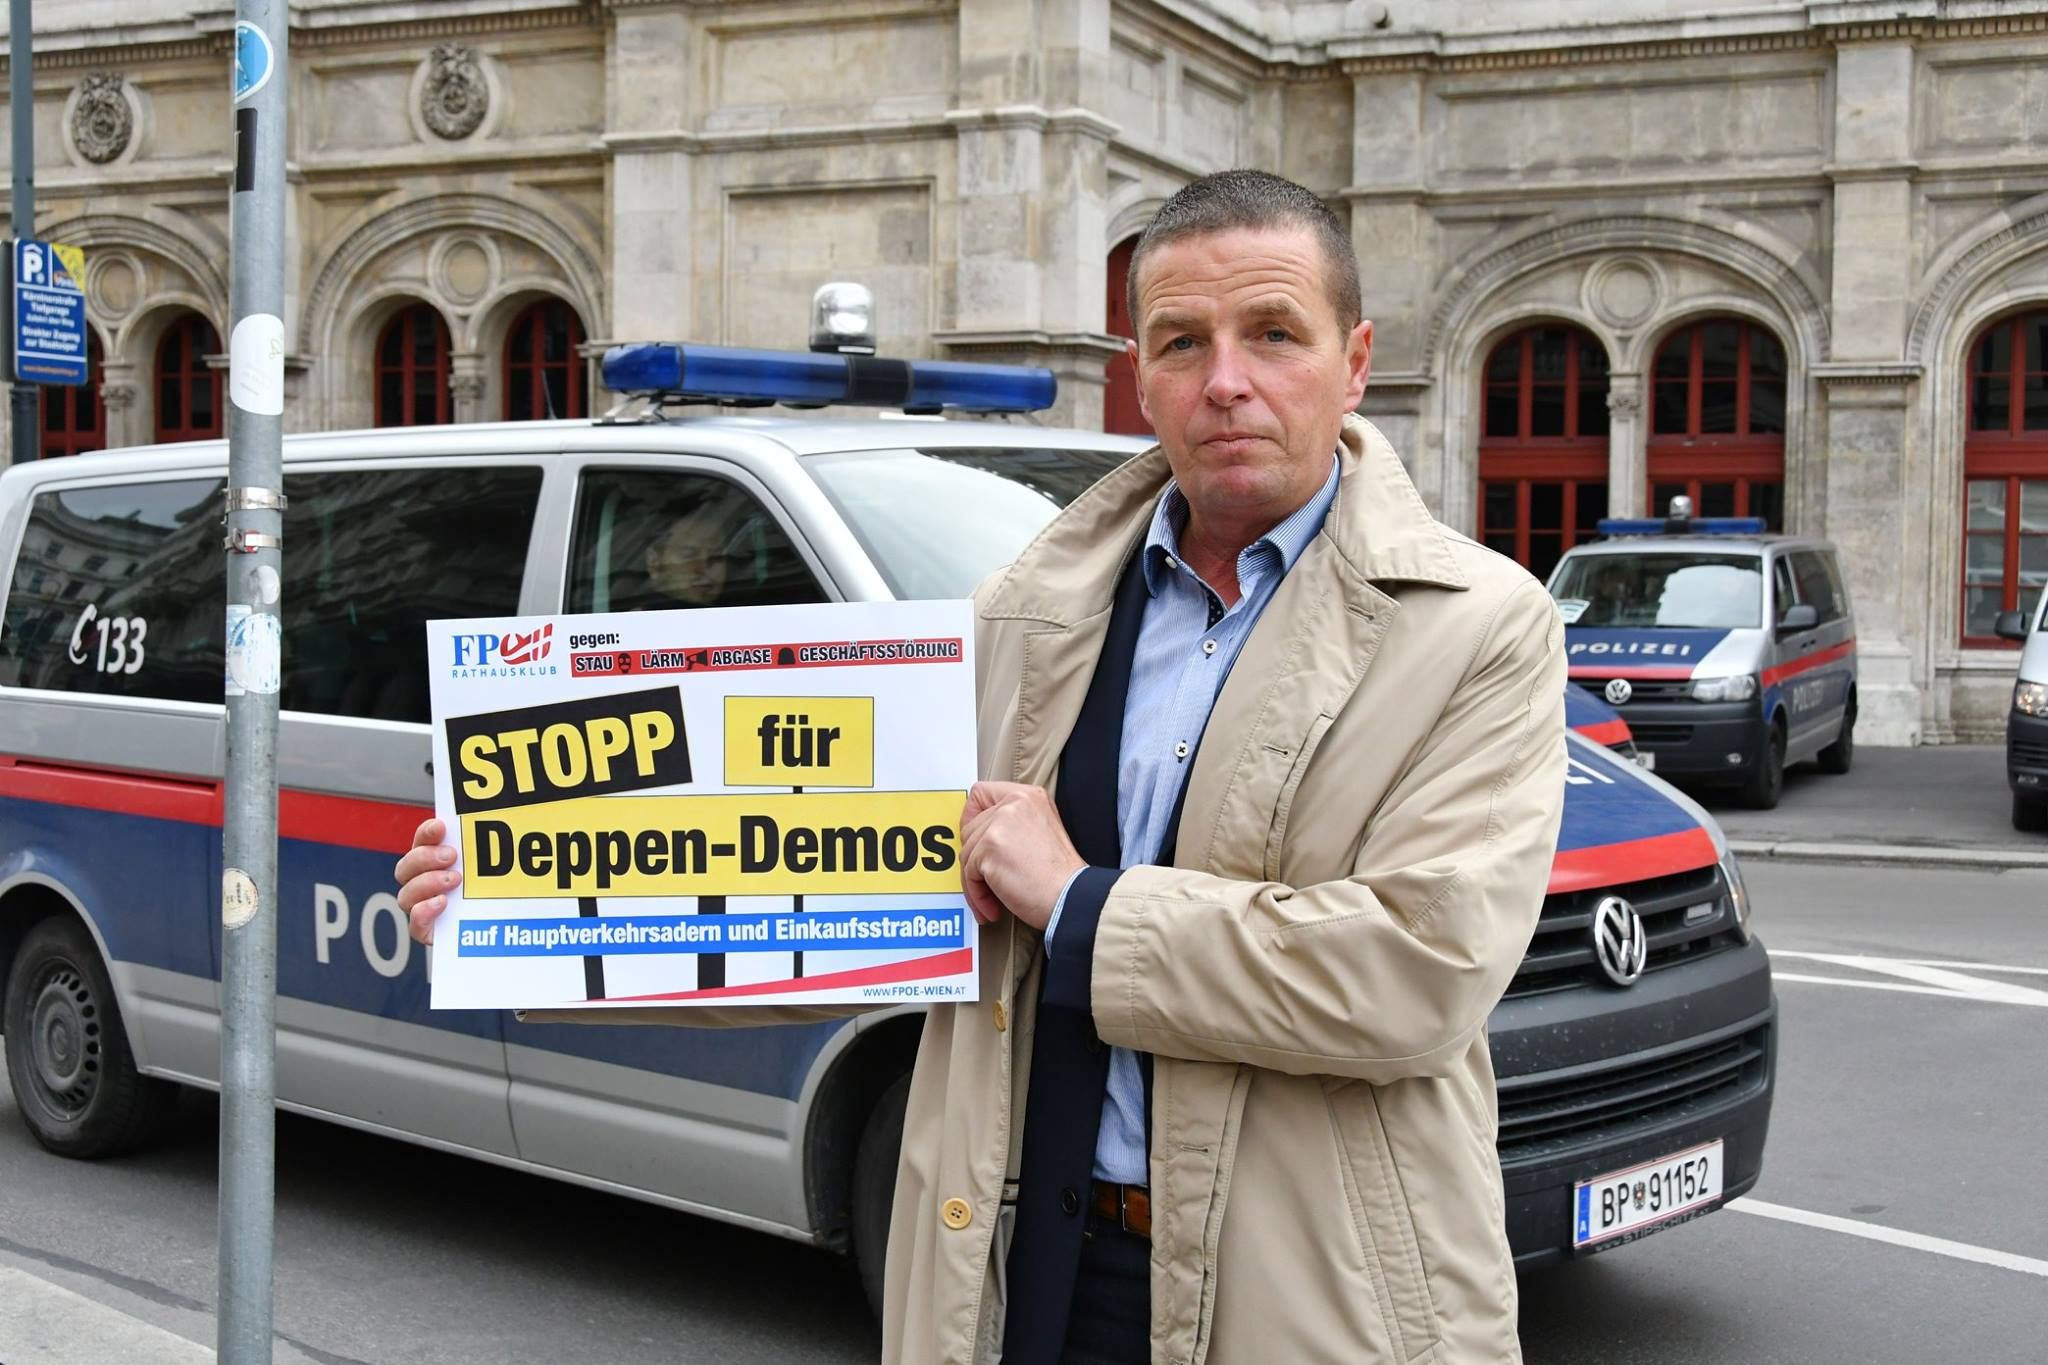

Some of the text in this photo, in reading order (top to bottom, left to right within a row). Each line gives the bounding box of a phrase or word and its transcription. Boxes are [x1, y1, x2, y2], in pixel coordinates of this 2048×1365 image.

[97, 616, 148, 675] 133
[569, 632, 621, 649] gegen:
[575, 640, 958, 672] STAU LÄRM ABGASE GESCHÄFTSSTÖRUNG
[1569, 642, 1691, 656] POLIZEI
[452, 666, 557, 679] RATHAUSKLUB
[459, 709, 675, 800] STOPP
[757, 714, 841, 768] für
[474, 814, 957, 890] Deppen-Demos
[461, 915, 961, 950] auf Hauptverkehrsadern und Einkaufsstraßen!
[1602, 1156, 1709, 1228] BP 91152
[1579, 1219, 1588, 1233] A
